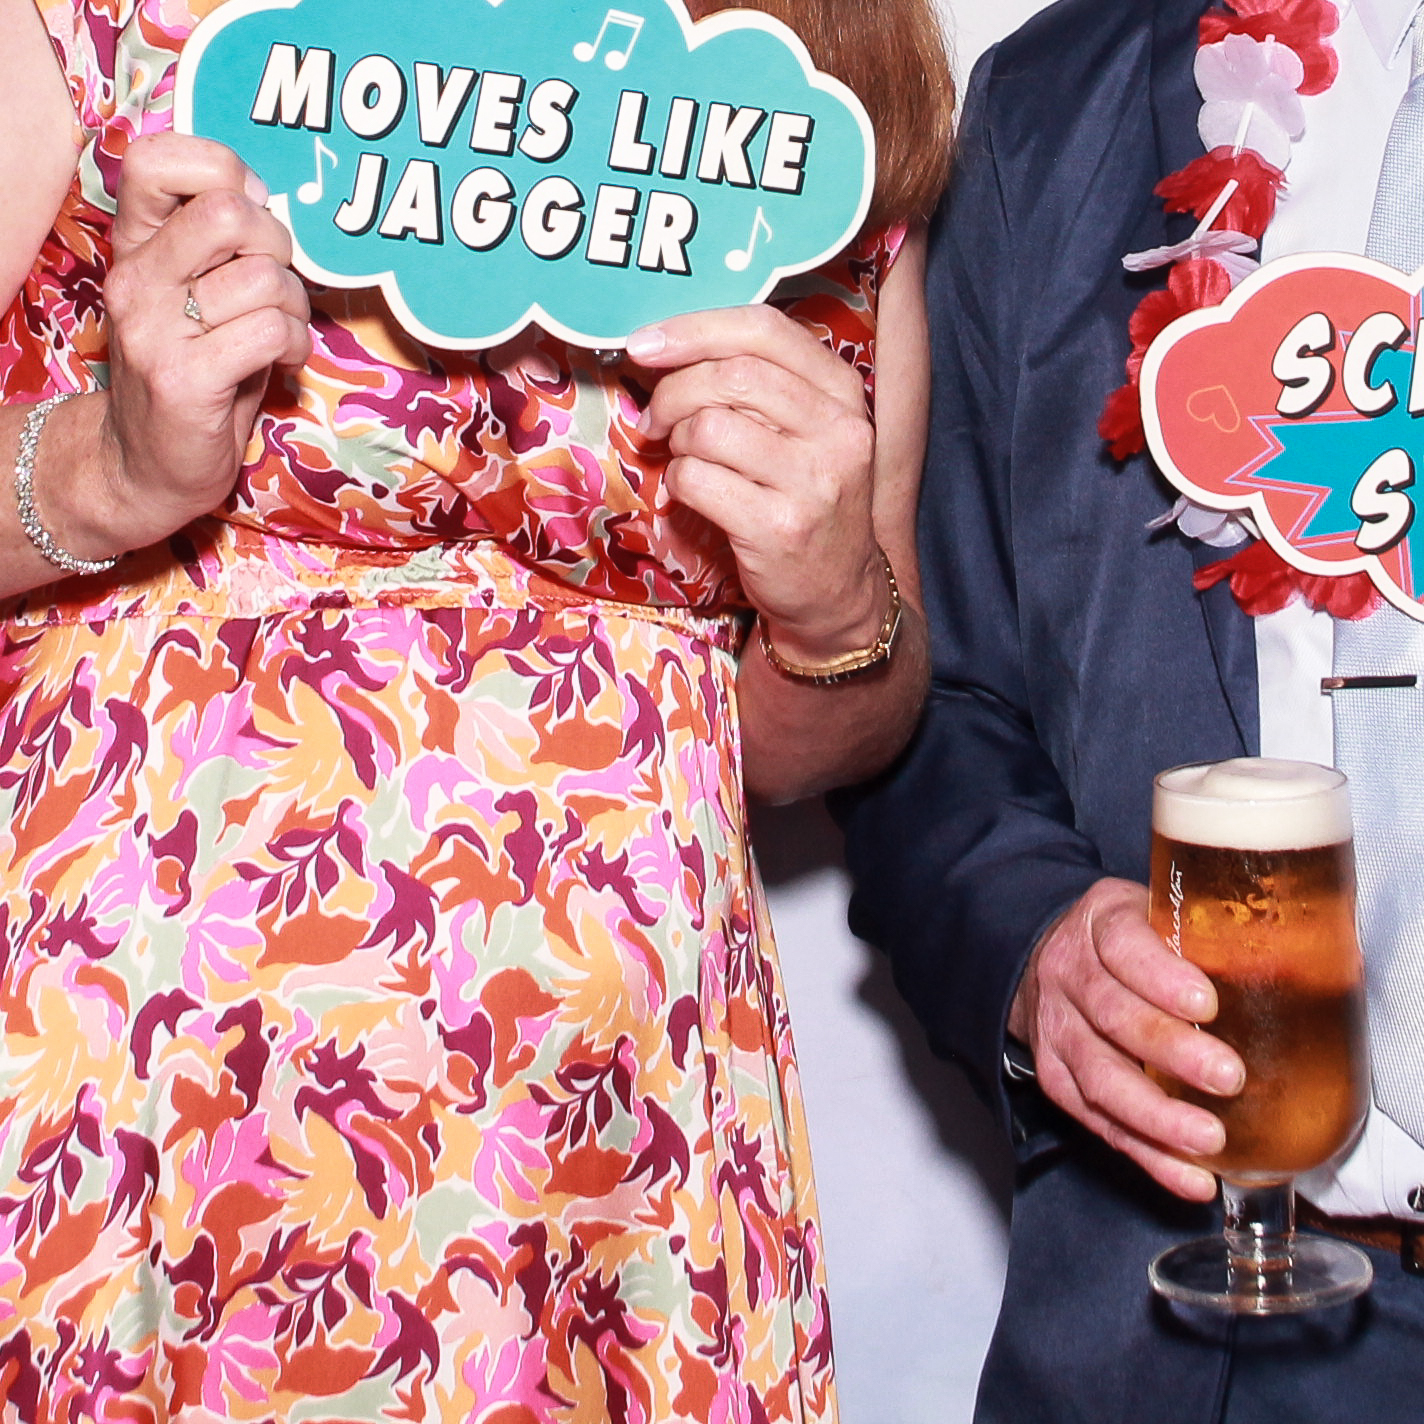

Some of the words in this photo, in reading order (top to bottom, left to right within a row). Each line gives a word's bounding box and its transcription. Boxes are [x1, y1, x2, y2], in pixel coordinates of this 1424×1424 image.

[250, 42, 580, 163] MOVES
[607, 89, 815, 195] LIKE
[333, 151, 698, 276] JAGGER
